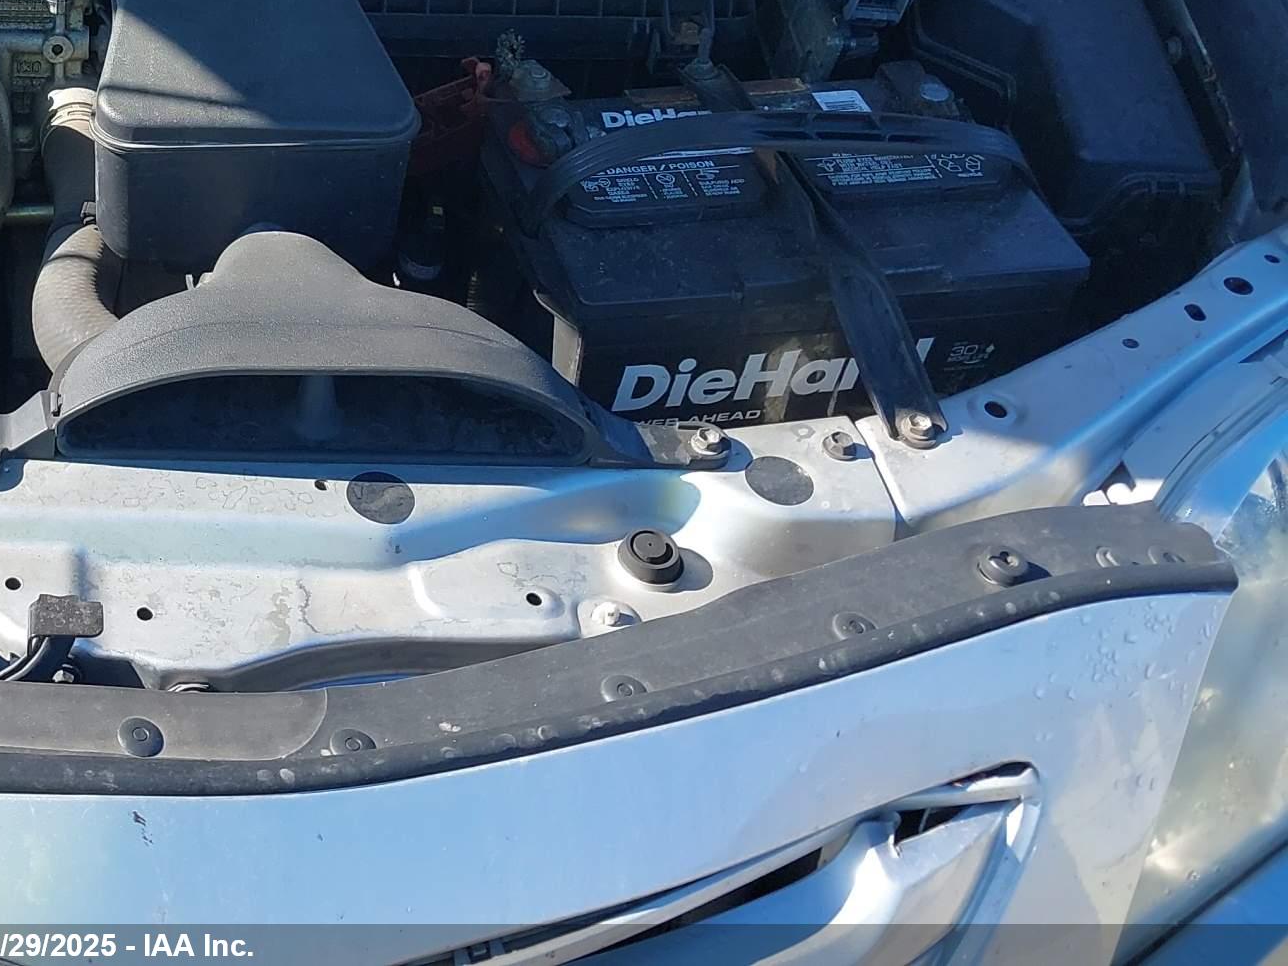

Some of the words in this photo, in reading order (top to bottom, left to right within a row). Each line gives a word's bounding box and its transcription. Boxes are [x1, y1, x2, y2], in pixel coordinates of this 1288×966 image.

[606, 165, 656, 175] DANGER
[669, 160, 715, 170] POISON
[611, 337, 936, 412] DieHar
[686, 410, 762, 424] AHEAD
